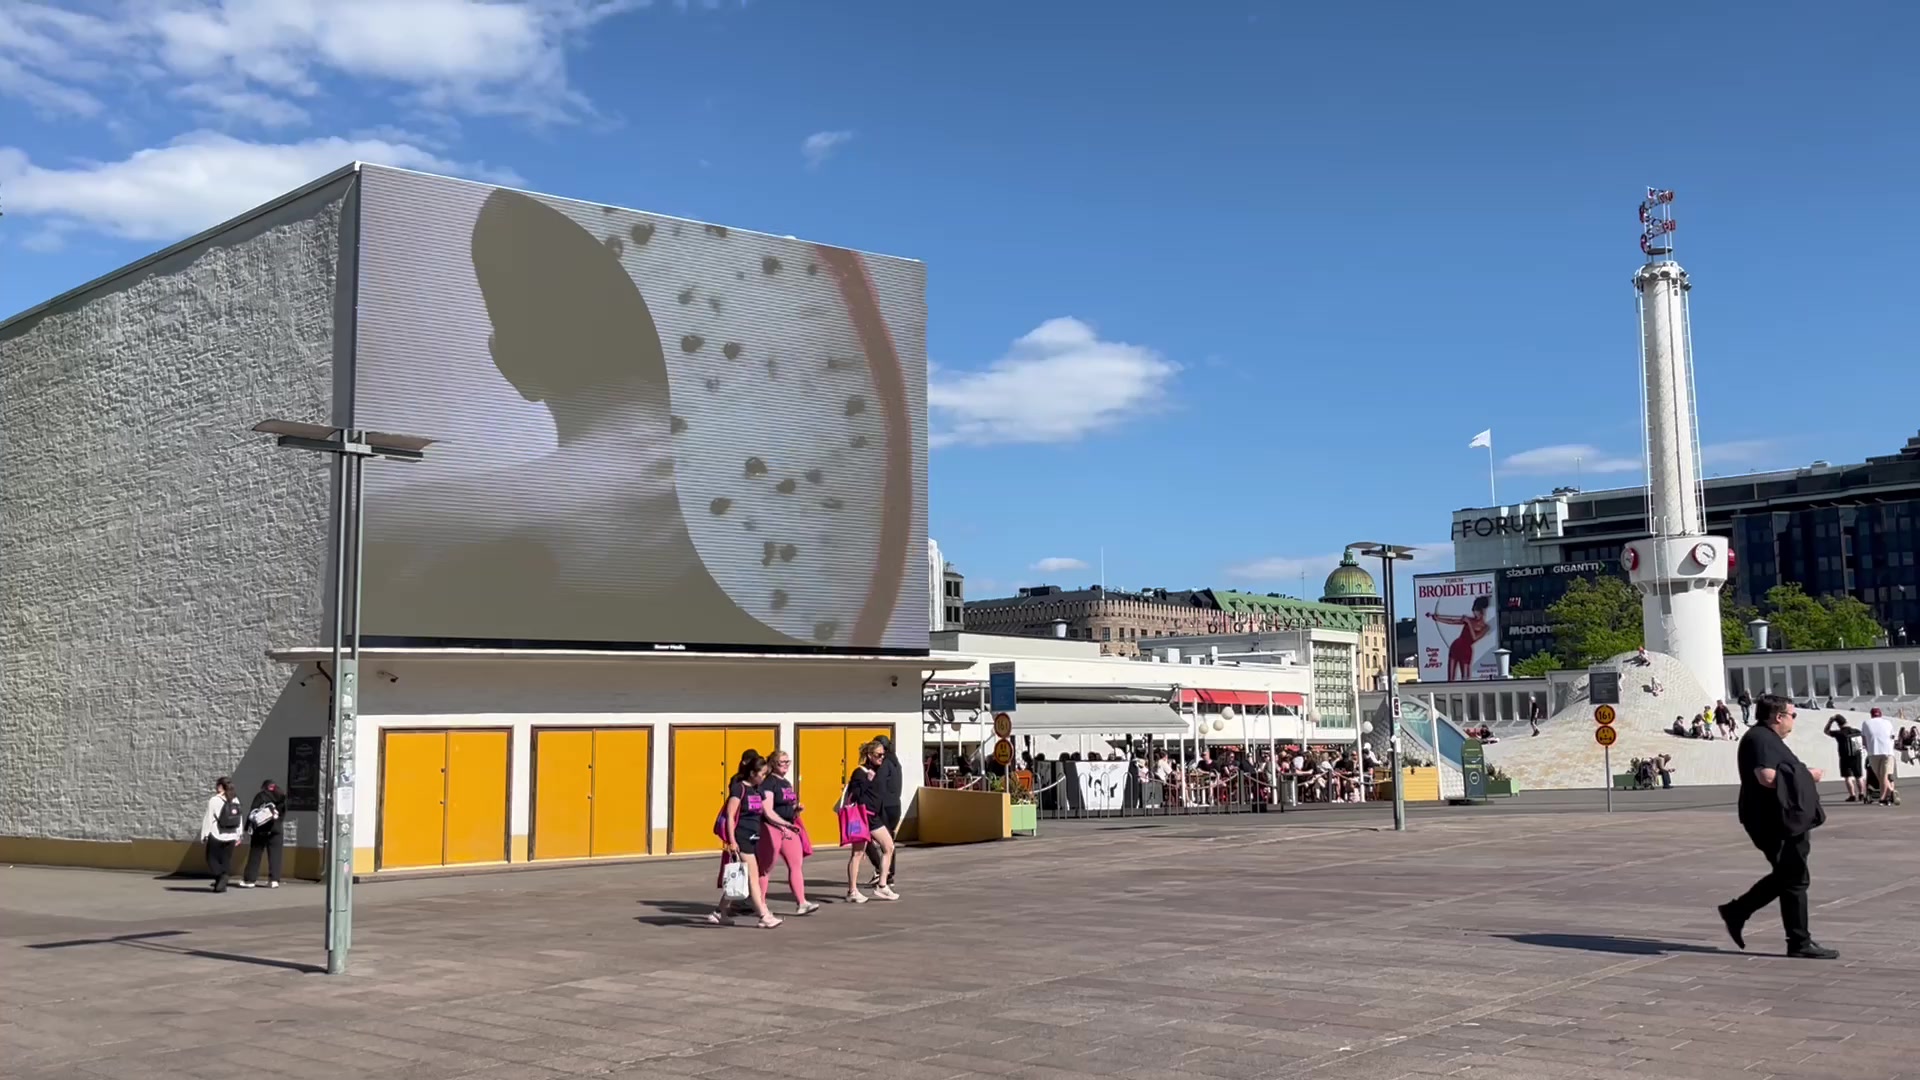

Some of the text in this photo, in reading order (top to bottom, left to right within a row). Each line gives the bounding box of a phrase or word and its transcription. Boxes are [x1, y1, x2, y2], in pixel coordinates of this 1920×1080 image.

[1462, 511, 1550, 538] FORUM
[1506, 566, 1544, 578] stadium
[1552, 562, 1598, 574] GIGANTTI
[1419, 581, 1492, 598] BROIDIETTE
